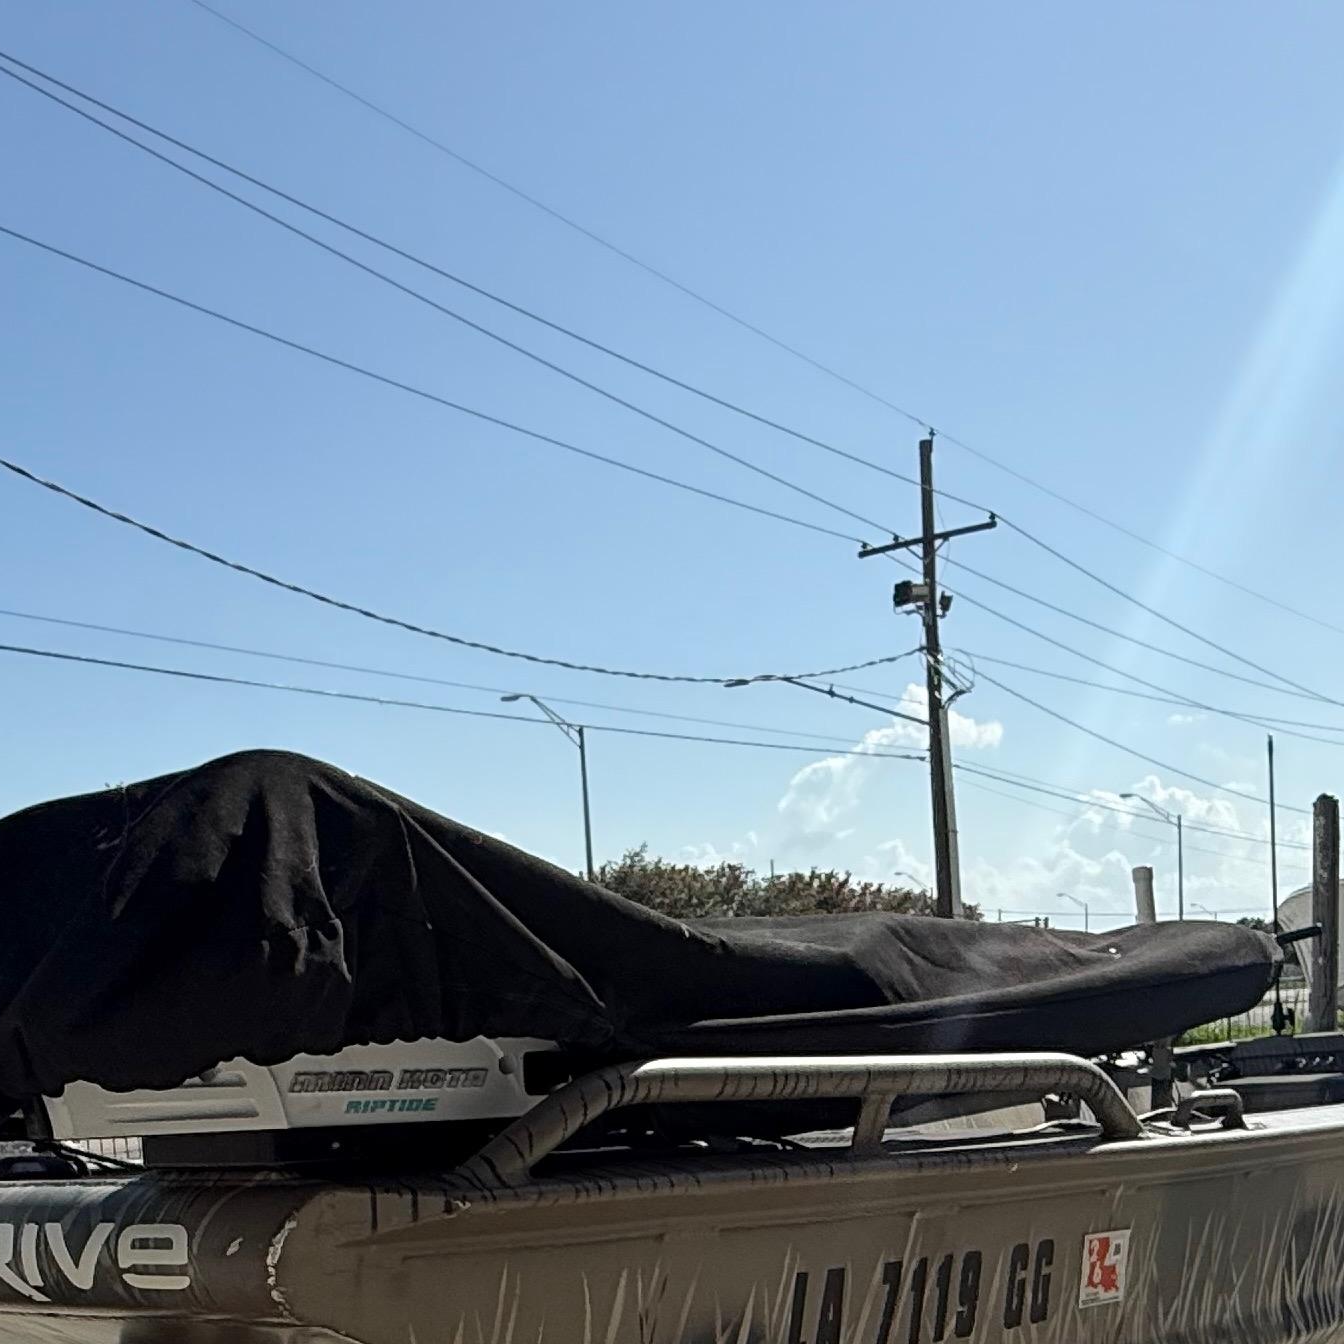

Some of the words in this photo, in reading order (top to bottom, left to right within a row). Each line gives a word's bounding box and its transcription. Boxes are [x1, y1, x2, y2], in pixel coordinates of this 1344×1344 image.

[397, 1068, 489, 1090] KOTA
[344, 1098, 438, 1114] RIPTIDE
[1004, 1239, 1054, 1330] GG
